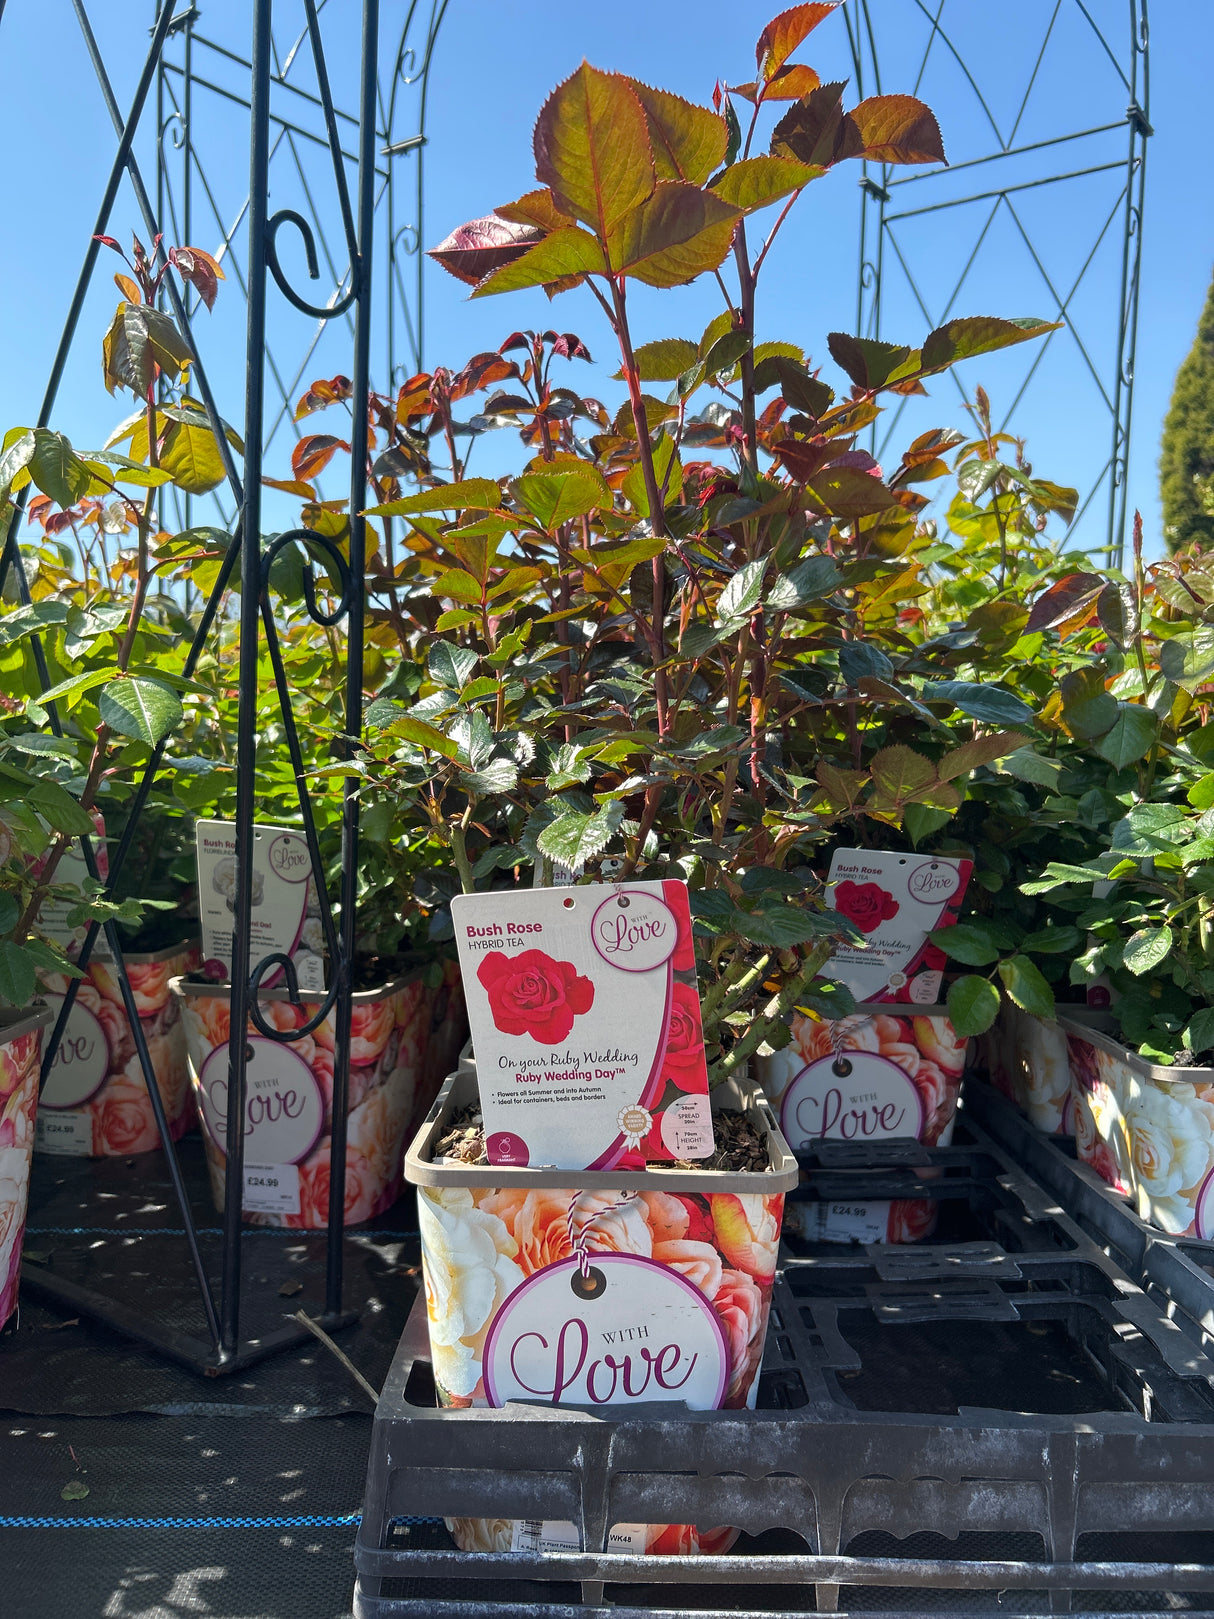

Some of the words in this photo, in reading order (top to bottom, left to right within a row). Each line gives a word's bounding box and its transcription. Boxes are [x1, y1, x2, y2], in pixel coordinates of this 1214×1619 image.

[203, 839, 224, 849] Bush
[273, 847, 309, 870] Love
[837, 864, 859, 873] Bush
[861, 866, 883, 876] Rose
[913, 872, 954, 893] Love
[631, 914, 648, 923] WITH
[466, 922, 503, 938] Bush
[506, 922, 543, 935] Rose
[600, 914, 667, 953] Love
[468, 939, 504, 950] HYBRID
[506, 937, 525, 948] TEA
[498, 1055, 517, 1069] On
[519, 1057, 548, 1073] your
[550, 1050, 580, 1070] Ruby
[583, 1048, 639, 1066] Wedding
[515, 1071, 541, 1084] Ruby
[543, 1068, 592, 1082] Wedding
[254, 1078, 280, 1089] WITH
[497, 1090, 519, 1098] Flowers
[523, 1096, 555, 1104] containers,
[555, 1094, 570, 1102] beds
[583, 1093, 606, 1101] borders
[849, 1092, 878, 1105] WITH
[247, 1176, 280, 1188] £24.99
[832, 1205, 867, 1218] £24.99
[601, 1325, 649, 1345] WITH
[510, 1318, 698, 1403] Love
[609, 1534, 632, 1543] WK48
